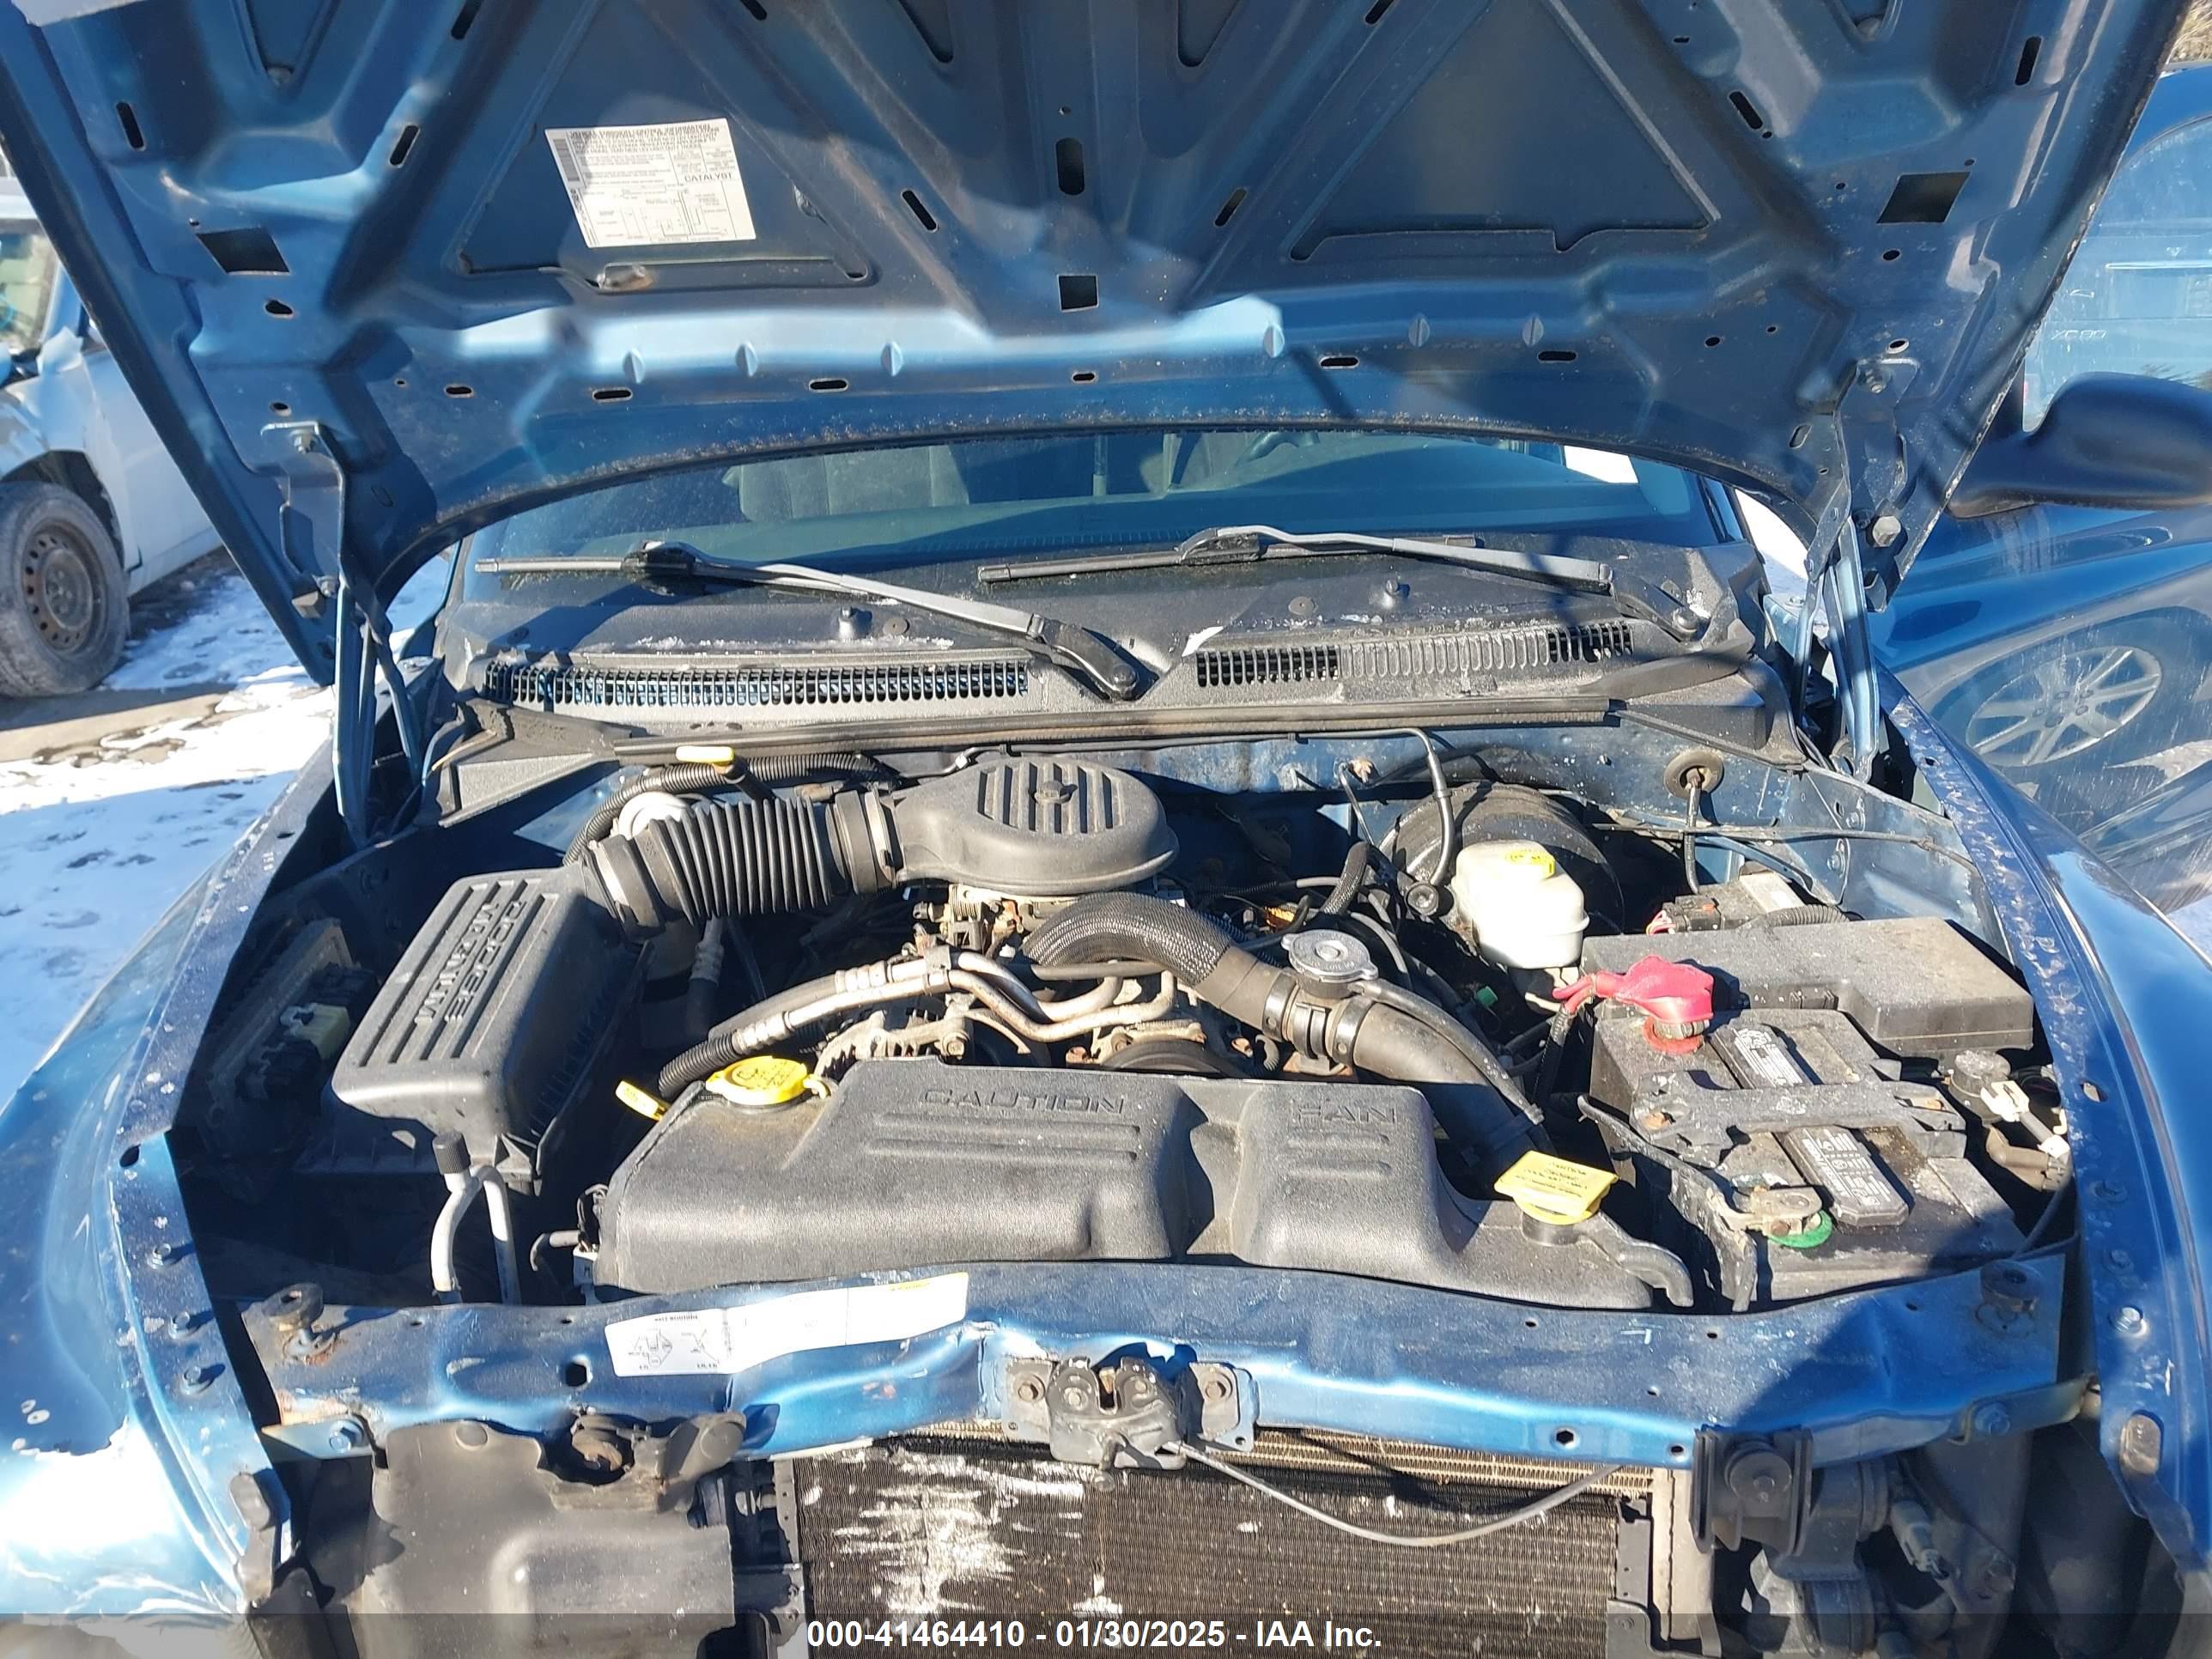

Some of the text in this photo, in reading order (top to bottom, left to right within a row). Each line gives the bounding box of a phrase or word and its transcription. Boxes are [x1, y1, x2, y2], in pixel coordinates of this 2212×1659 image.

[444, 900, 527, 1022] DODGE
[921, 1089, 1125, 1114] CAUTION
[1297, 1104, 1397, 1124] FAN
